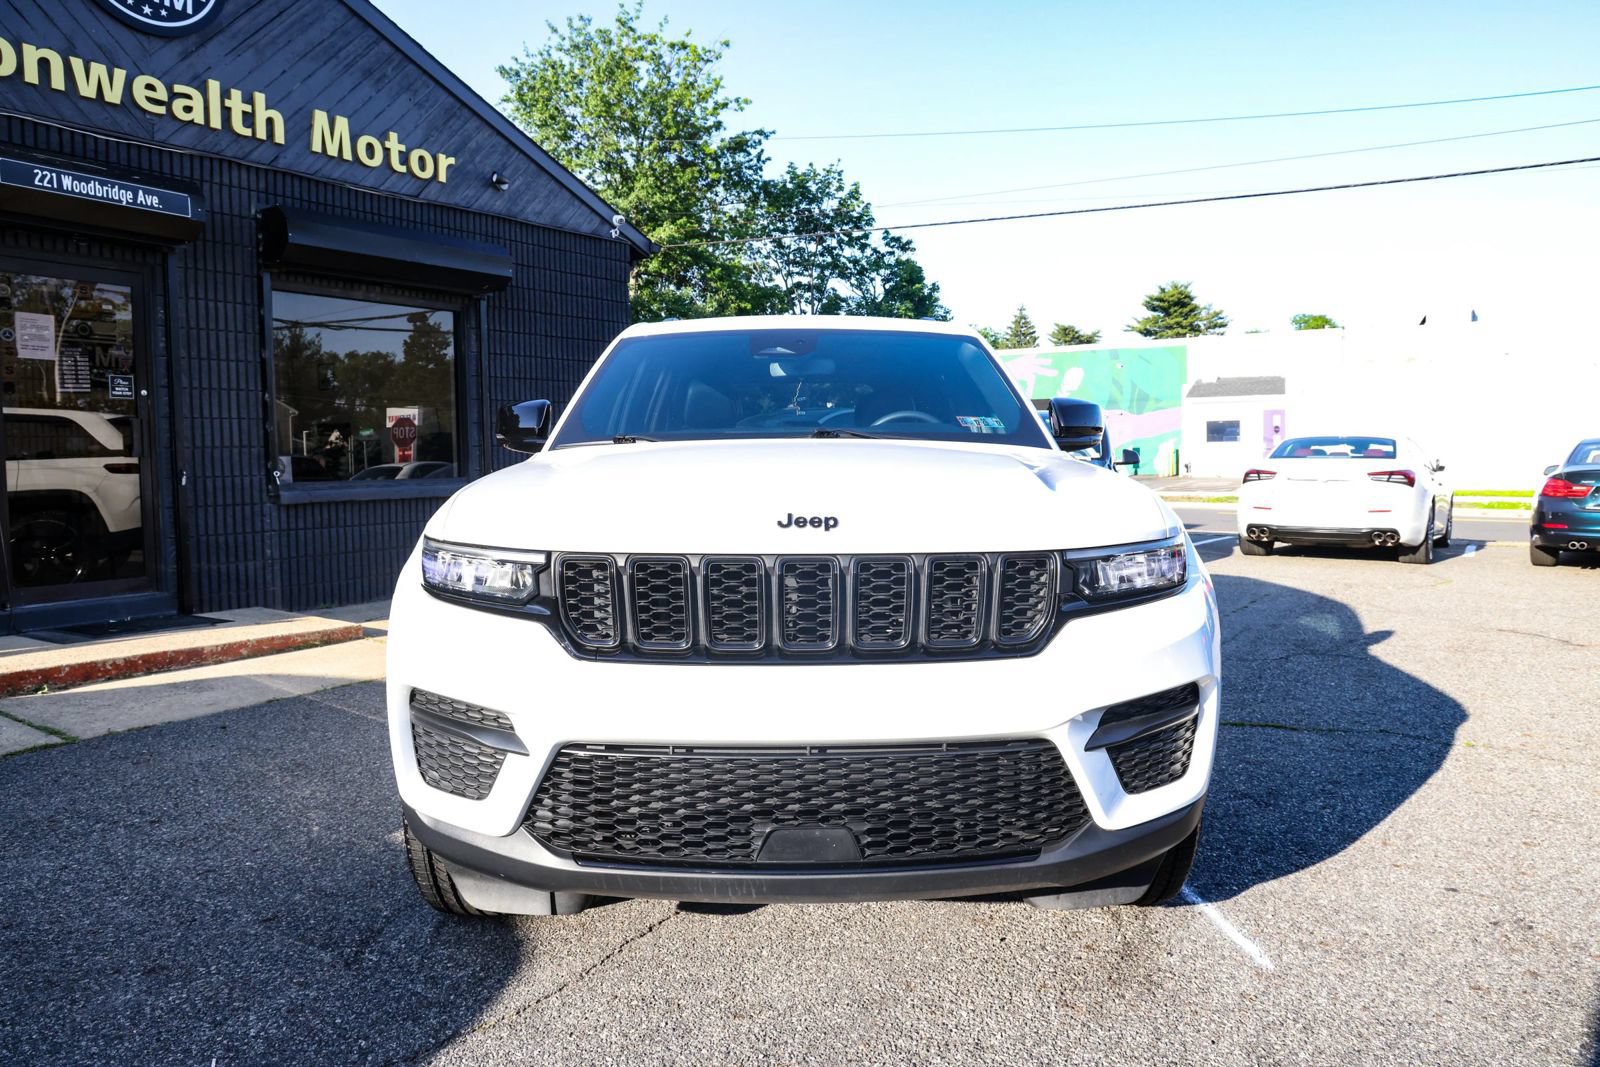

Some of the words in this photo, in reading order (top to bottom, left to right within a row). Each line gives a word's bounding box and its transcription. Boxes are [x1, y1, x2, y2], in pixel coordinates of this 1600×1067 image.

[311, 109, 456, 184] Motor
[33, 169, 58, 189] 221
[61, 174, 133, 205] Woodbridge
[137, 190, 163, 209] Ave.
[777, 513, 839, 531] Jeep
